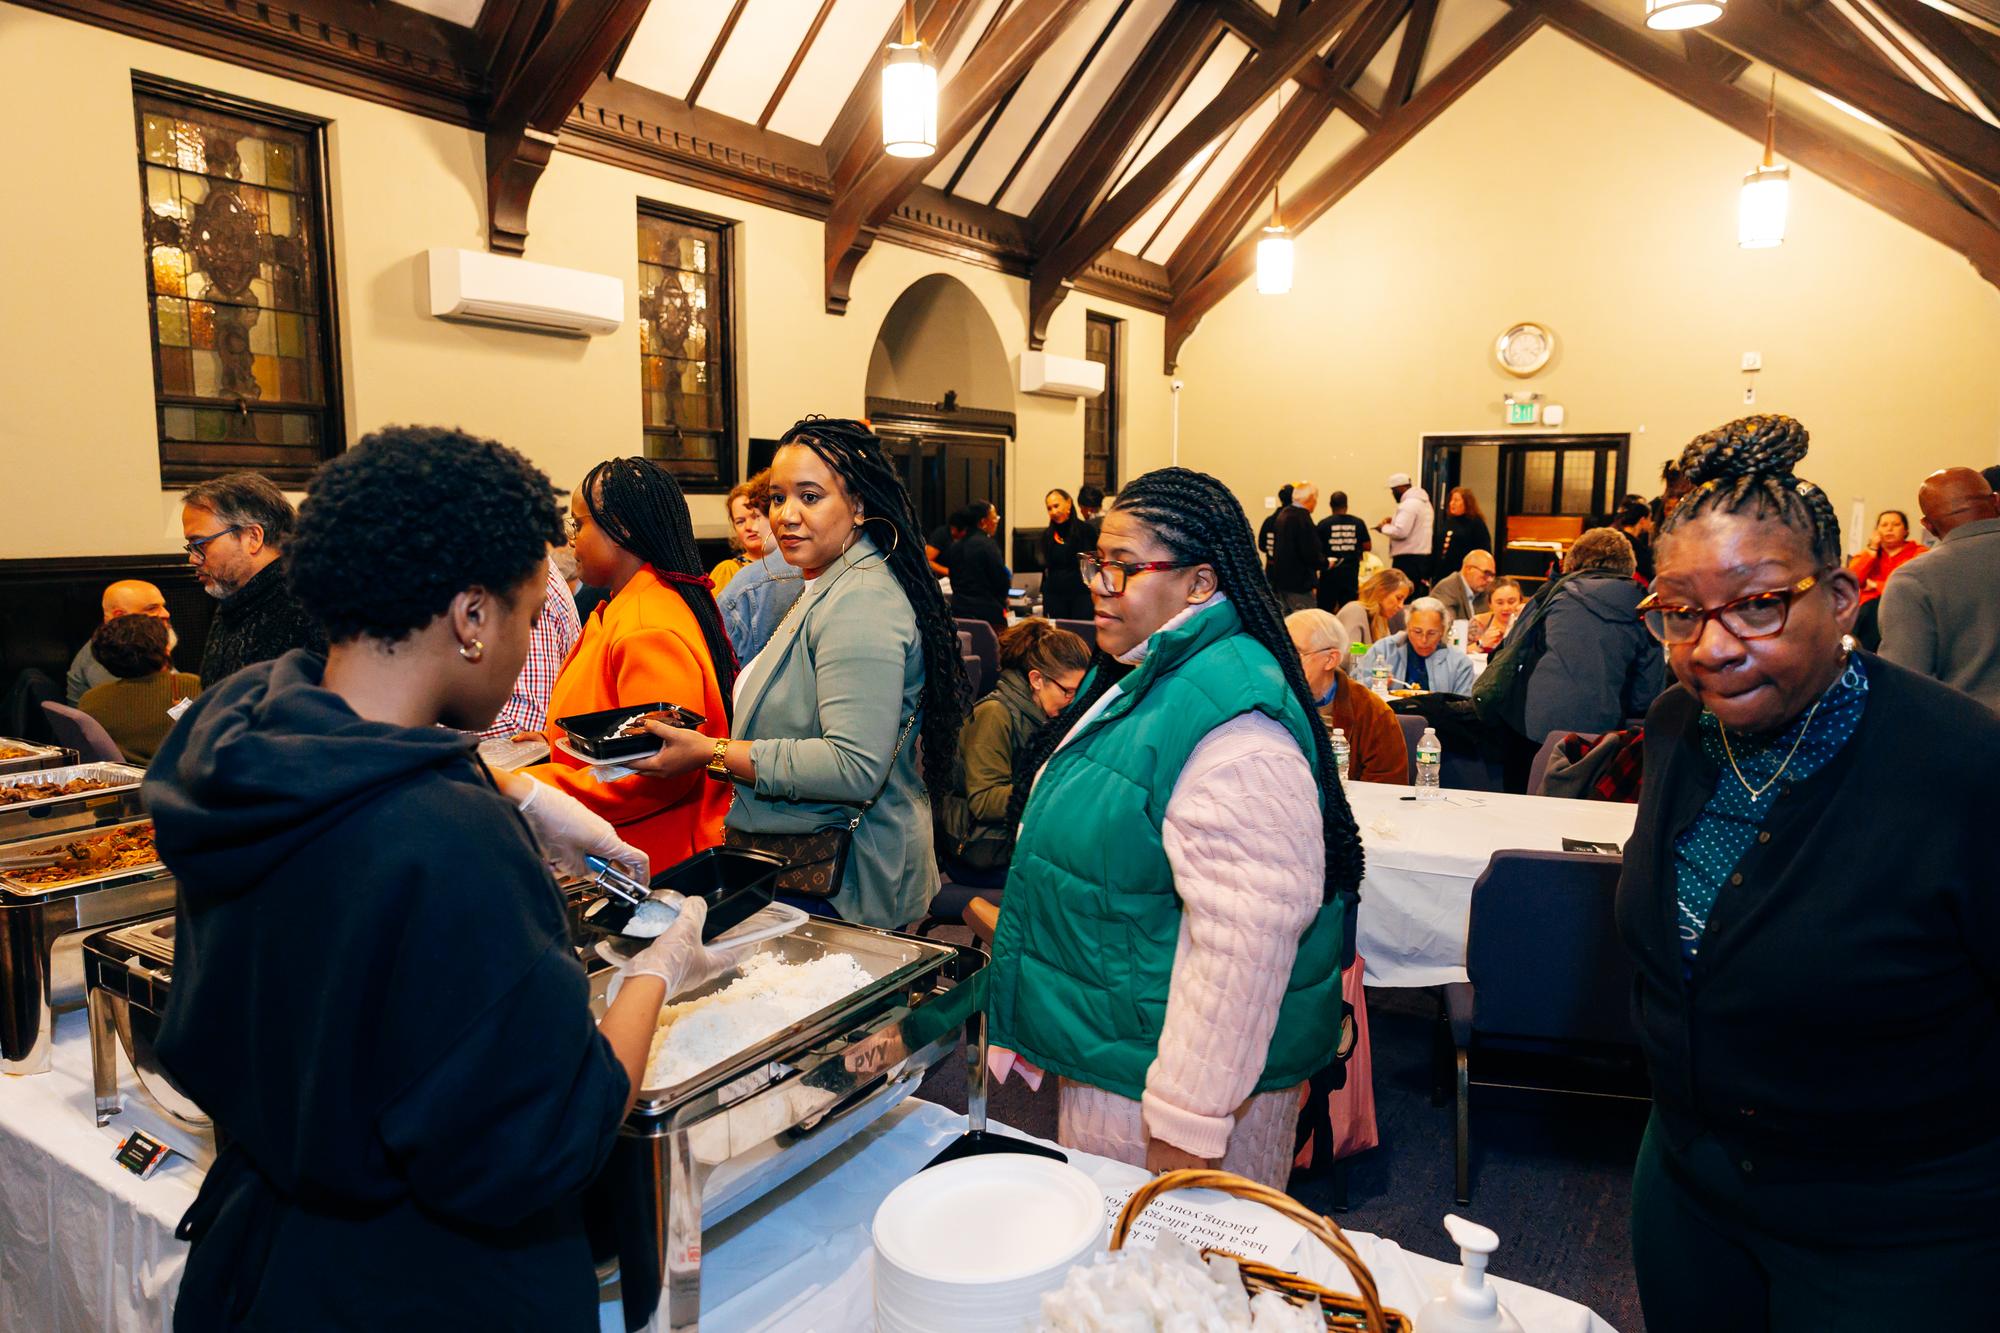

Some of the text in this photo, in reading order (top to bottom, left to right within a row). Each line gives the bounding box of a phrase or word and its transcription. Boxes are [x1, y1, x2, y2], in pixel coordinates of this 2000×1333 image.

[1512, 404, 1534, 422] EXIT
[1166, 1204, 1203, 1219] your
[1203, 1213, 1258, 1235] placing
[1190, 1225, 1226, 1241] food
[1229, 1235, 1239, 1243] a
[1241, 1239, 1269, 1255] has
